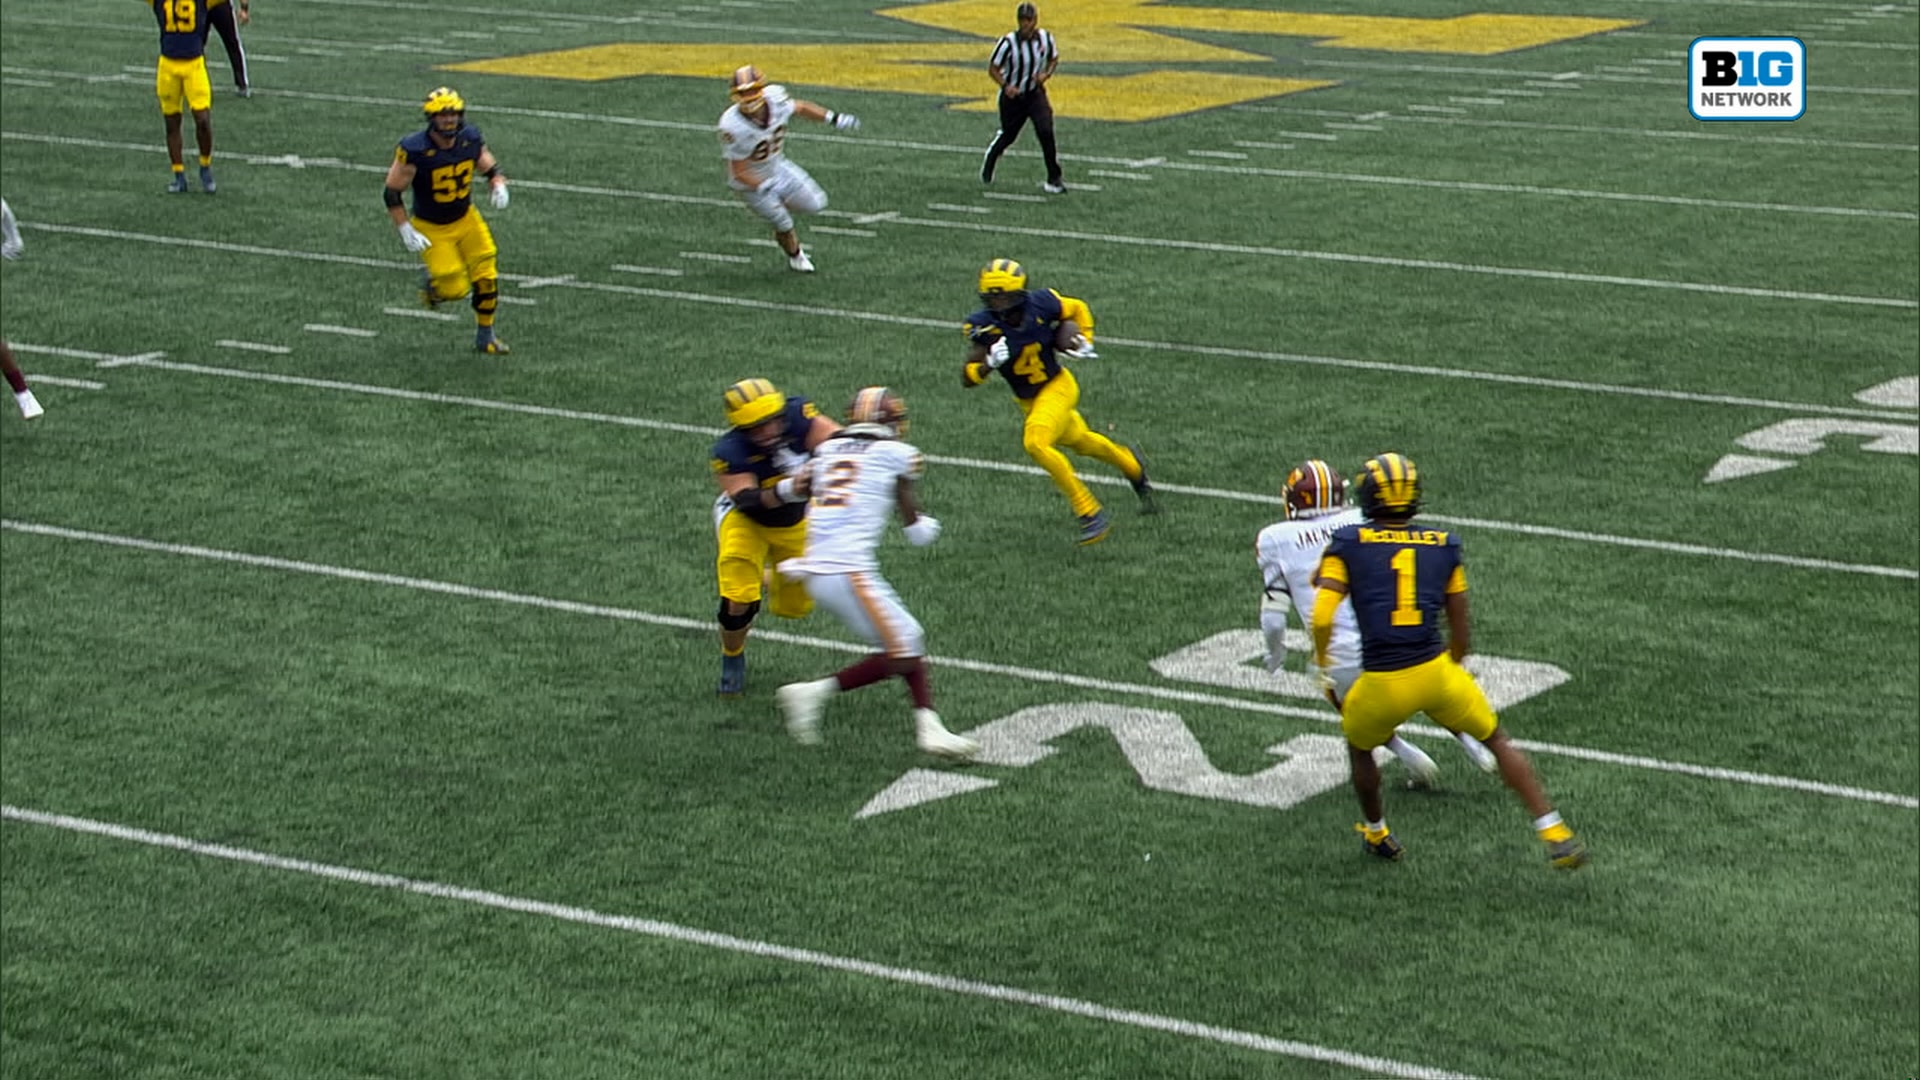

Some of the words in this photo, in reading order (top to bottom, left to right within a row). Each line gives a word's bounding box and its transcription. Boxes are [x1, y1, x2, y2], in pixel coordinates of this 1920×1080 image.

[163, 0, 197, 33] 19
[431, 159, 475, 203] 53
[1012, 342, 1049, 385] 4
[1296, 521, 1355, 551] JACK
[1390, 548, 1424, 626] 1
